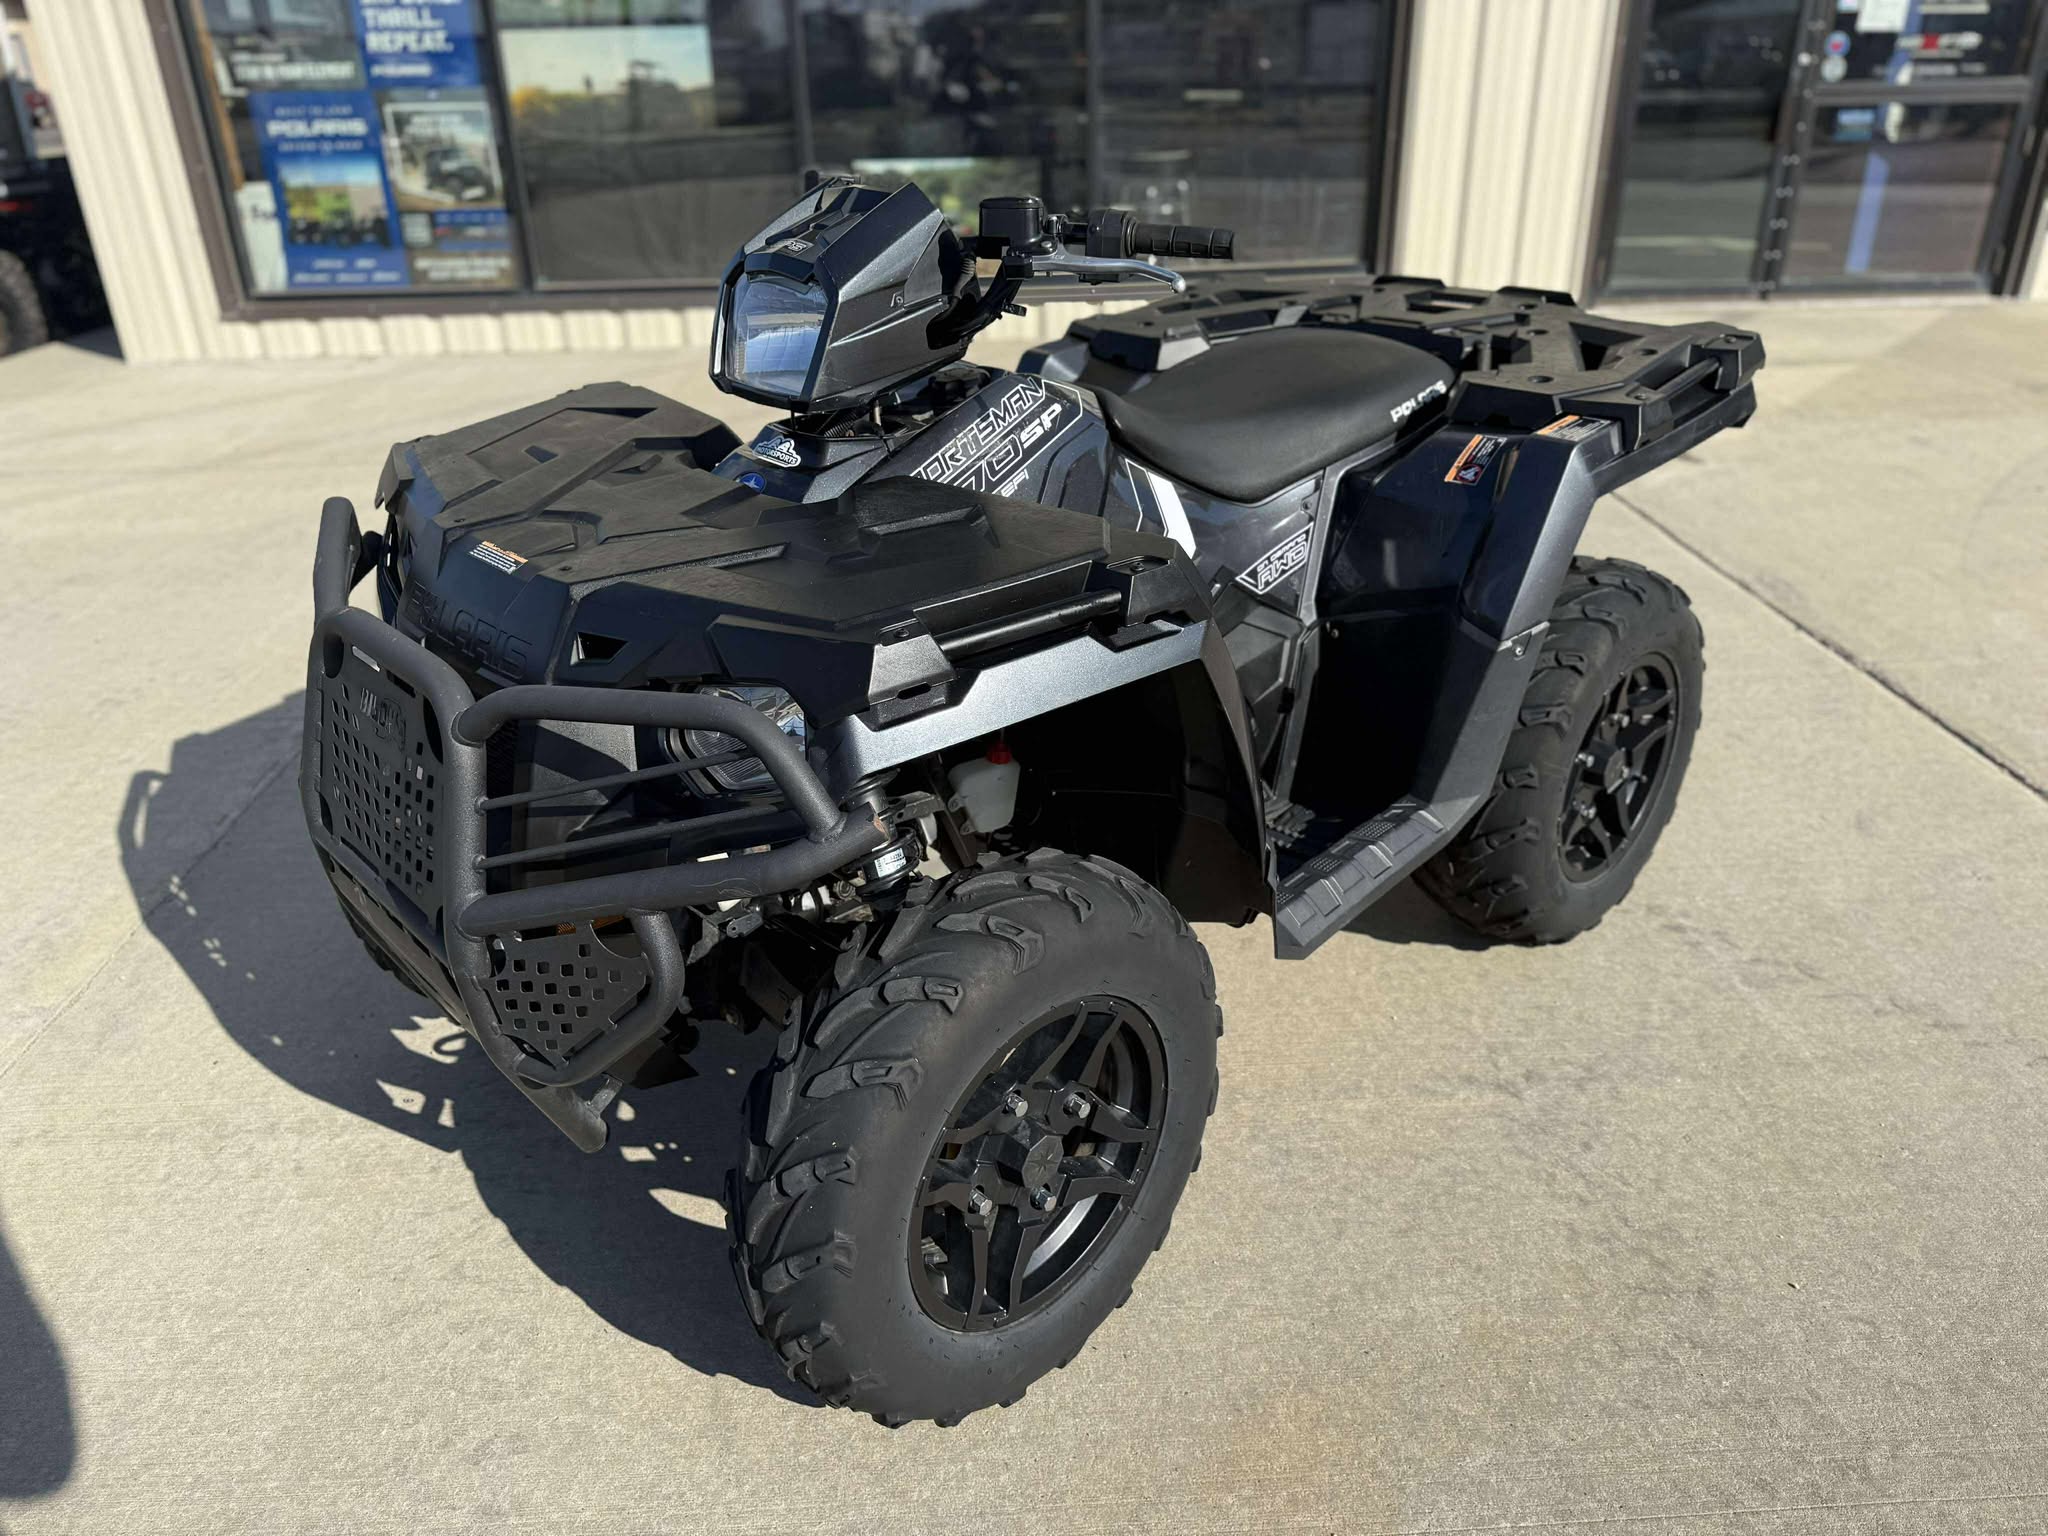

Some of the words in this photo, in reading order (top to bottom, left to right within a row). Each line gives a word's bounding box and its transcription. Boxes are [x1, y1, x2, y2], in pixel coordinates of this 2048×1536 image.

[362, 7, 445, 29] THRILL.
[365, 30, 454, 53] REPEAT.
[266, 118, 368, 138] POLARIS
[1390, 380, 1447, 423] POLARIS
[891, 377, 1043, 484] ORTSMAN
[757, 446, 798, 465] MOTORSPORTS
[952, 434, 1023, 492] 70
[1020, 403, 1063, 449] SP
[1001, 468, 1030, 498] EFI
[1258, 541, 1307, 590] AWD
